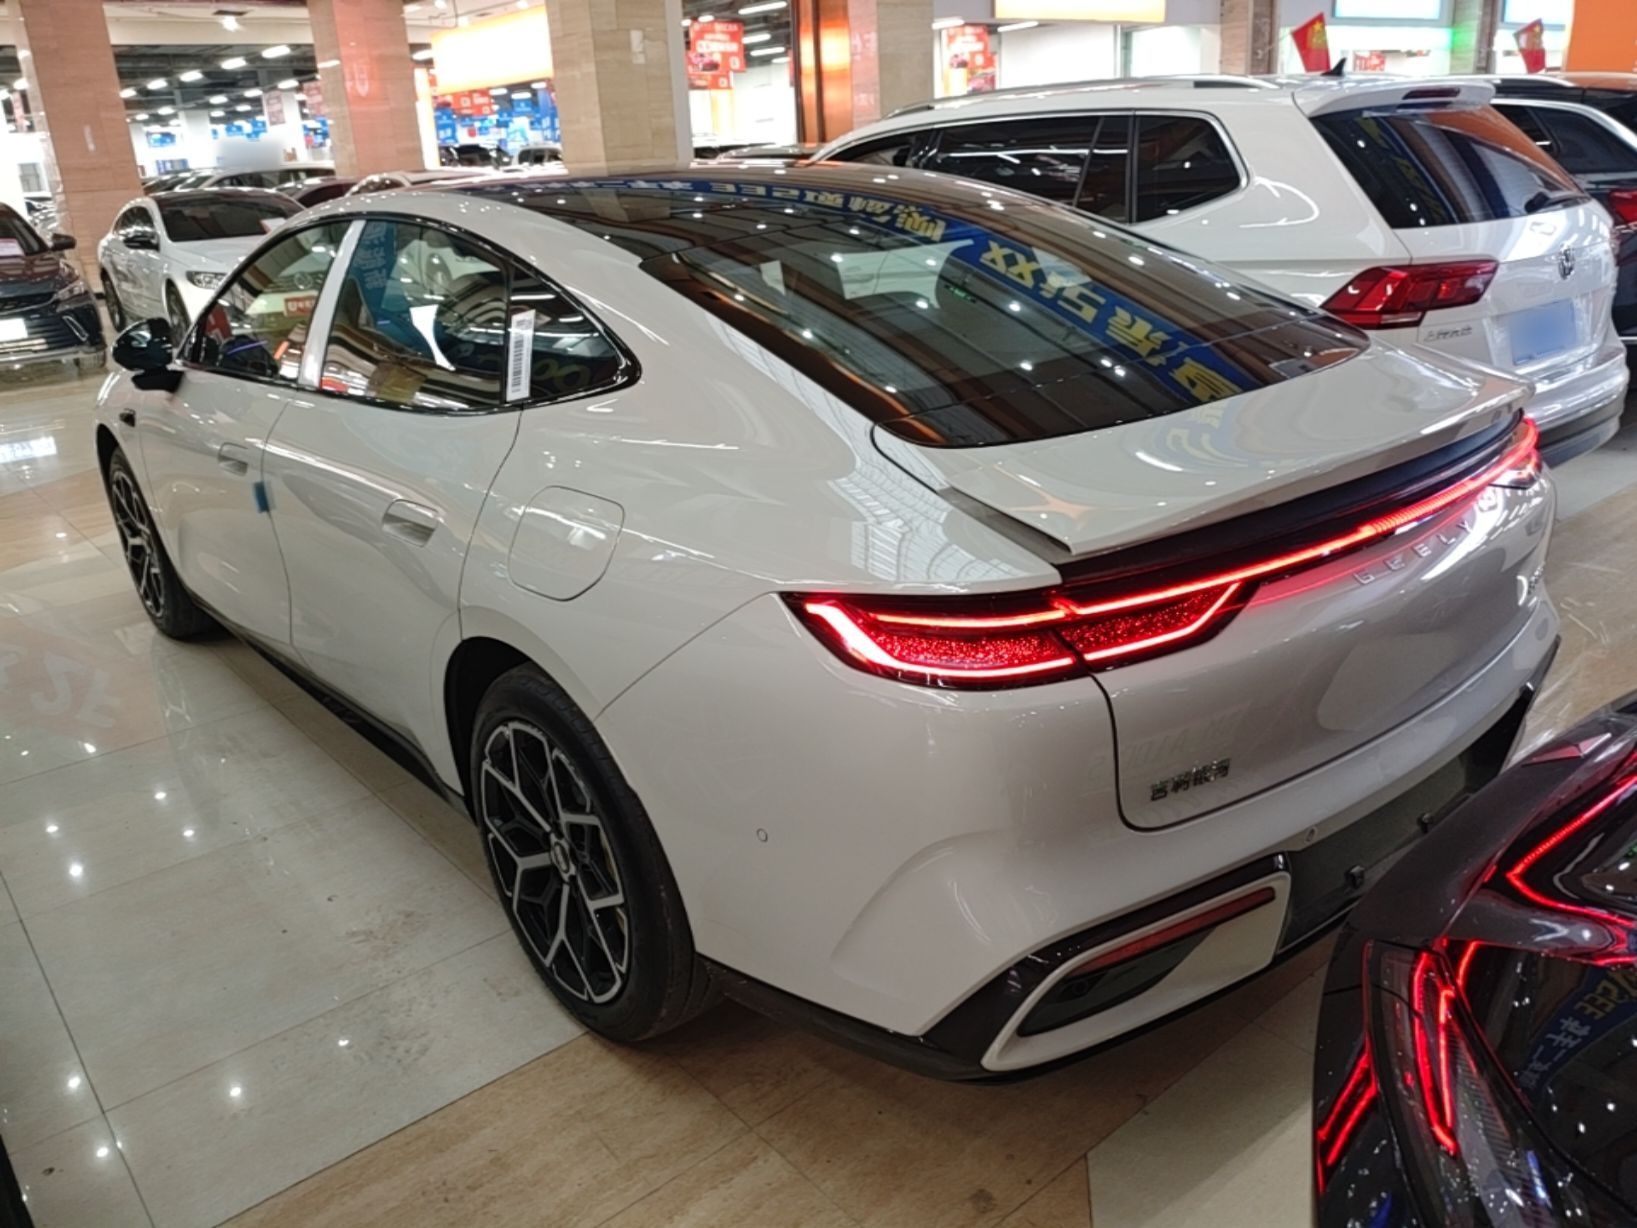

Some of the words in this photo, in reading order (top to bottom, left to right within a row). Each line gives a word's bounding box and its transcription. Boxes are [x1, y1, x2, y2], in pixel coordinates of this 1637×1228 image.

[1353, 519, 1473, 585] GEELY
[1150, 757, 1231, 802] 吉利银河
